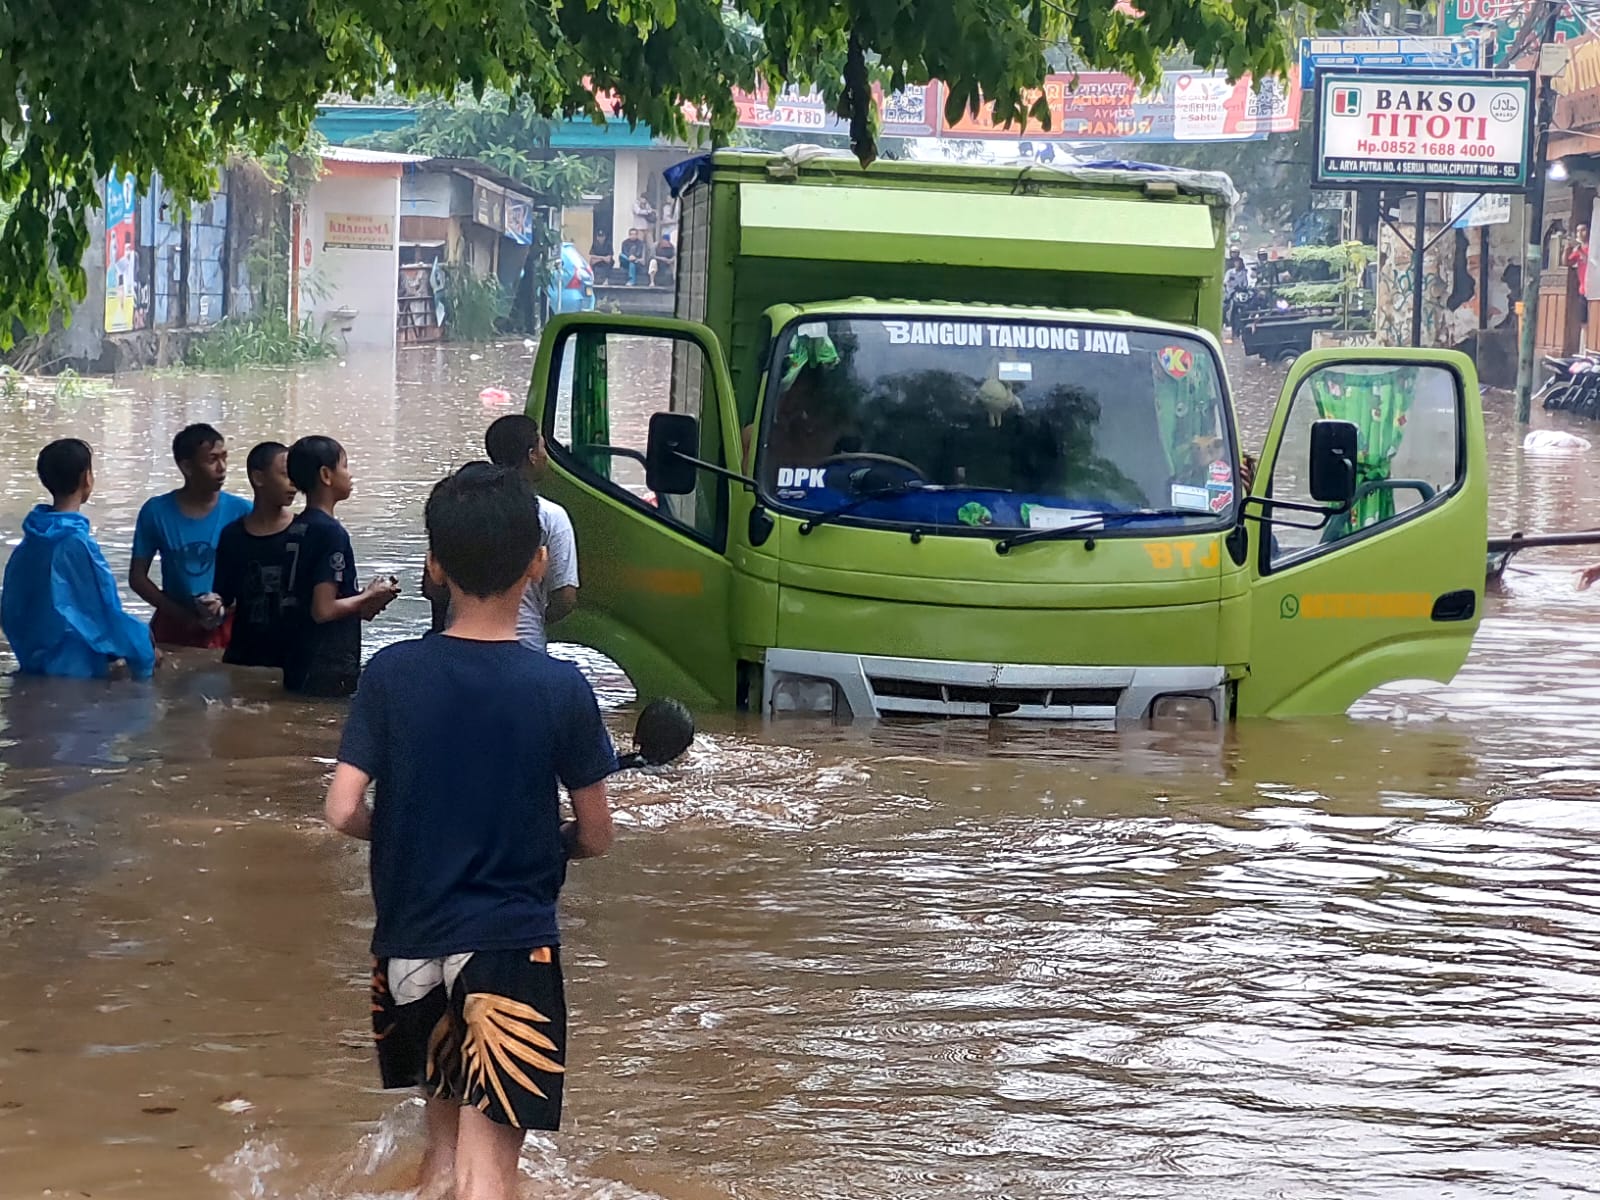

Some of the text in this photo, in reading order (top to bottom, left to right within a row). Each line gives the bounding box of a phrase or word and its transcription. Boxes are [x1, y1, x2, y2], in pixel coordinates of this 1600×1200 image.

[1376, 89, 1476, 113] BAKSO
[1367, 113, 1488, 141] TITOTI
[1357, 139, 1495, 158] Hp.0852 1688 4000
[1328, 161, 1339, 170] JL.
[1340, 162, 1358, 171] ARYA
[1359, 162, 1382, 172] PUTRA
[1480, 165, 1498, 176] TANG
[1503, 166, 1516, 177] SEL
[882, 320, 1130, 355] BANGUN TANJONG JAYA
[777, 468, 826, 488] DPK
[1144, 542, 1218, 569] BTJ
